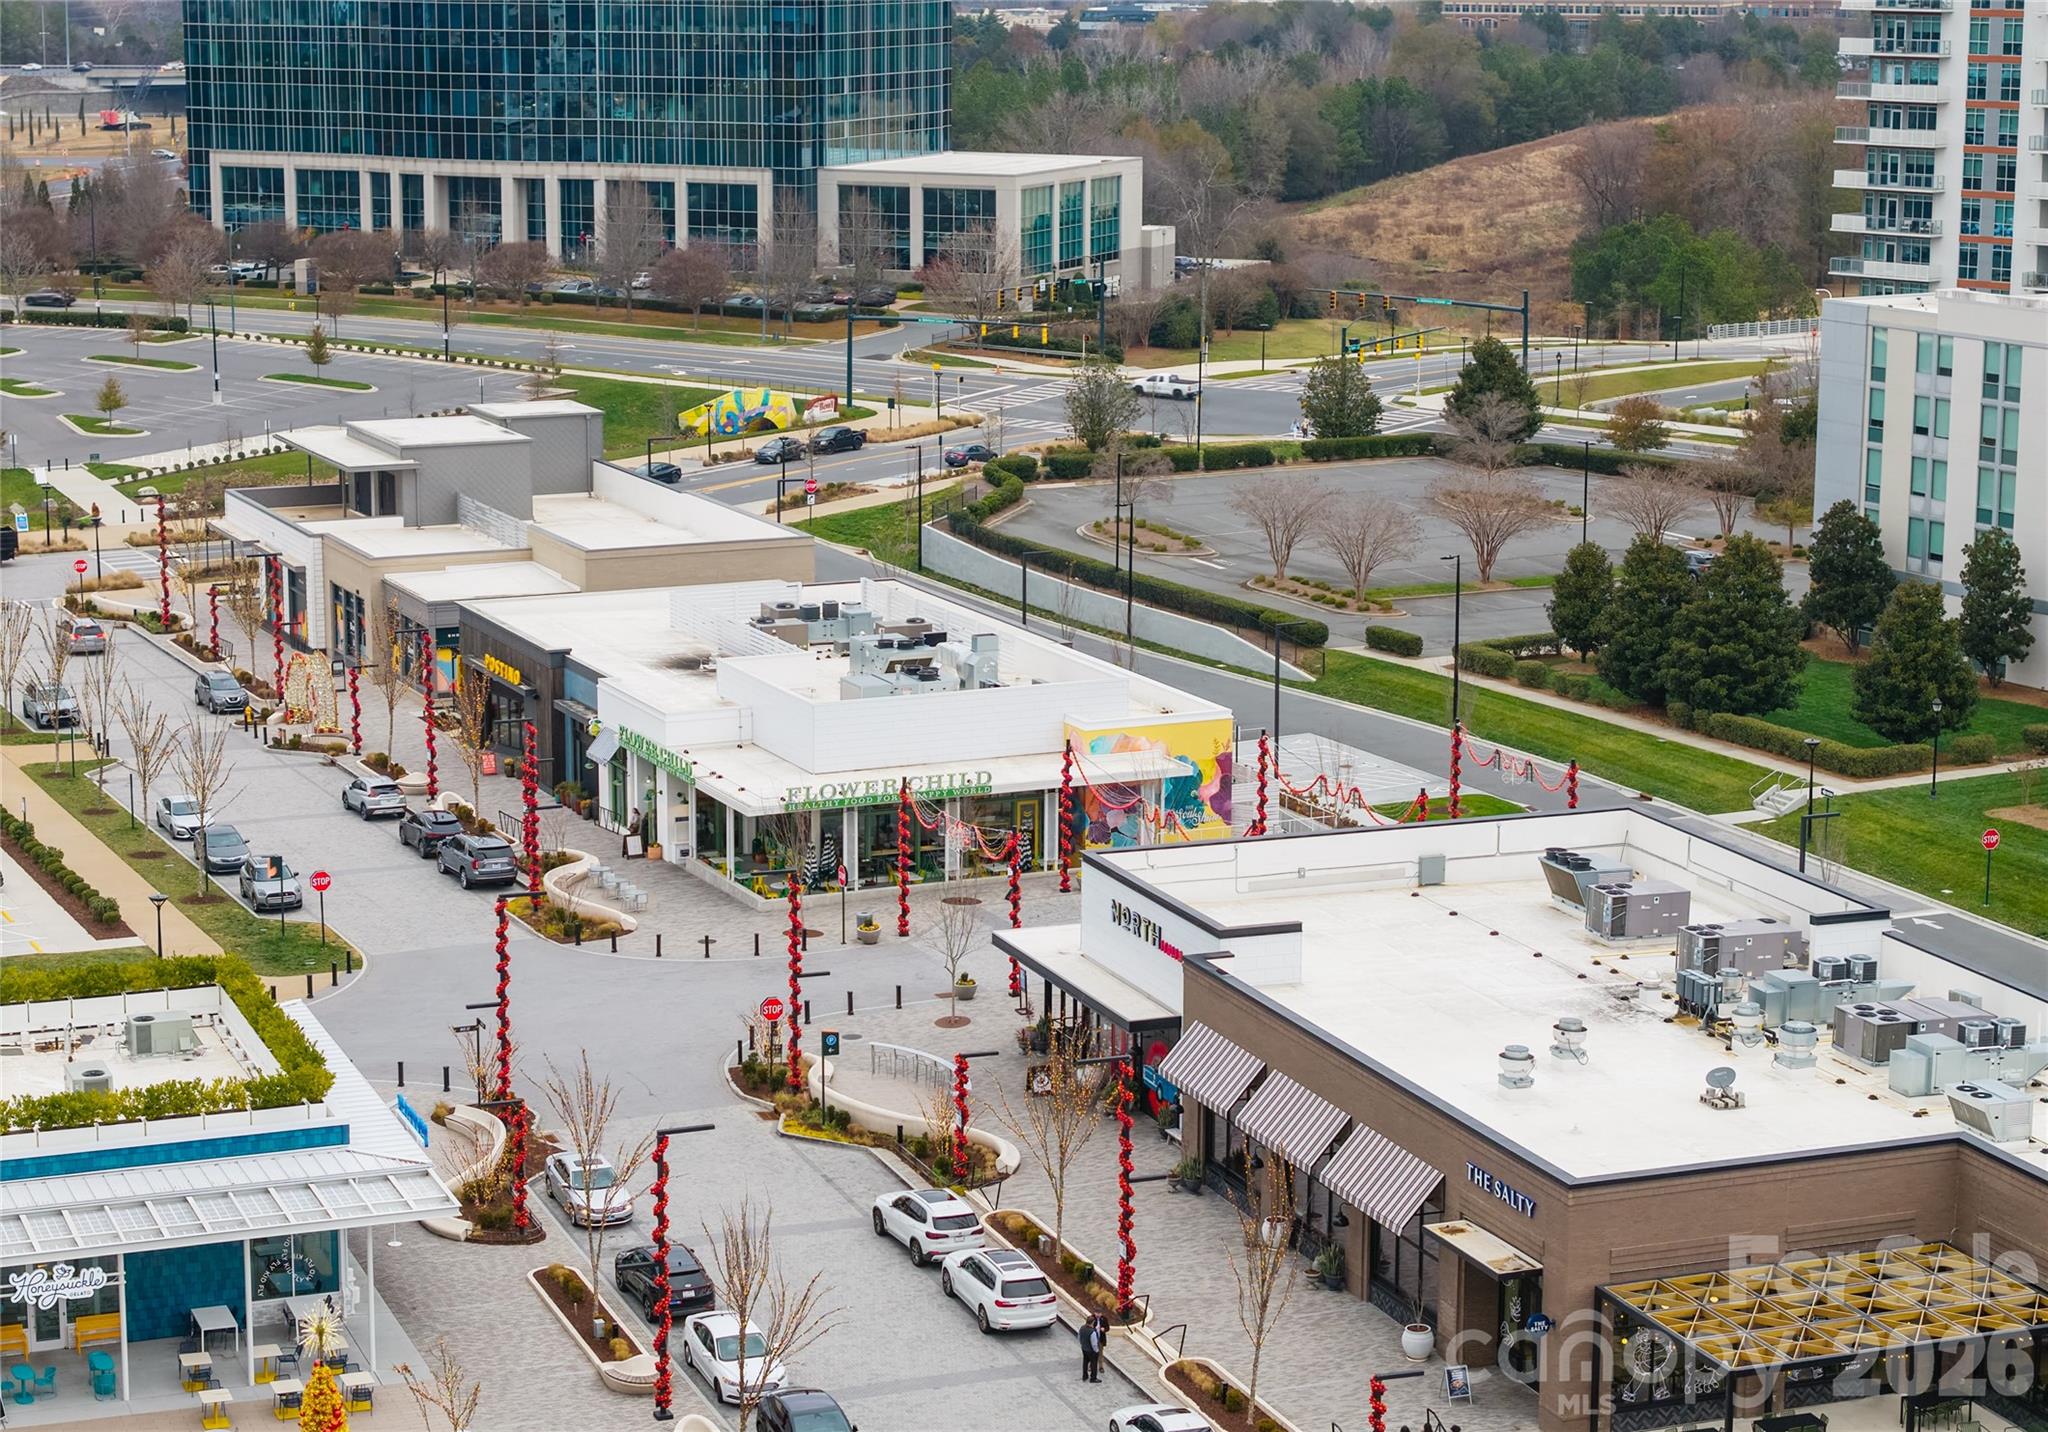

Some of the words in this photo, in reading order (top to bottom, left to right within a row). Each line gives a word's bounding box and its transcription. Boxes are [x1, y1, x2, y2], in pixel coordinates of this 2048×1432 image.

[484, 653, 521, 685] POSTINO
[786, 778, 898, 803] FLOWER
[909, 770, 992, 790] CHILD
[788, 800, 840, 811] HEALTHY
[844, 796, 873, 806] FOOD
[877, 793, 898, 802] FOR
[953, 786, 991, 796] WORLD
[1983, 835, 1999, 844] STOP
[312, 876, 330, 887] STOP
[1111, 898, 1162, 950] NORTH
[763, 1004, 783, 1015] STOP
[1466, 1161, 1491, 1193] THE
[1494, 1180, 1535, 1217] SALTY
[10, 1270, 105, 1308] Honeysuckle
[257, 1284, 265, 1297] FLY
